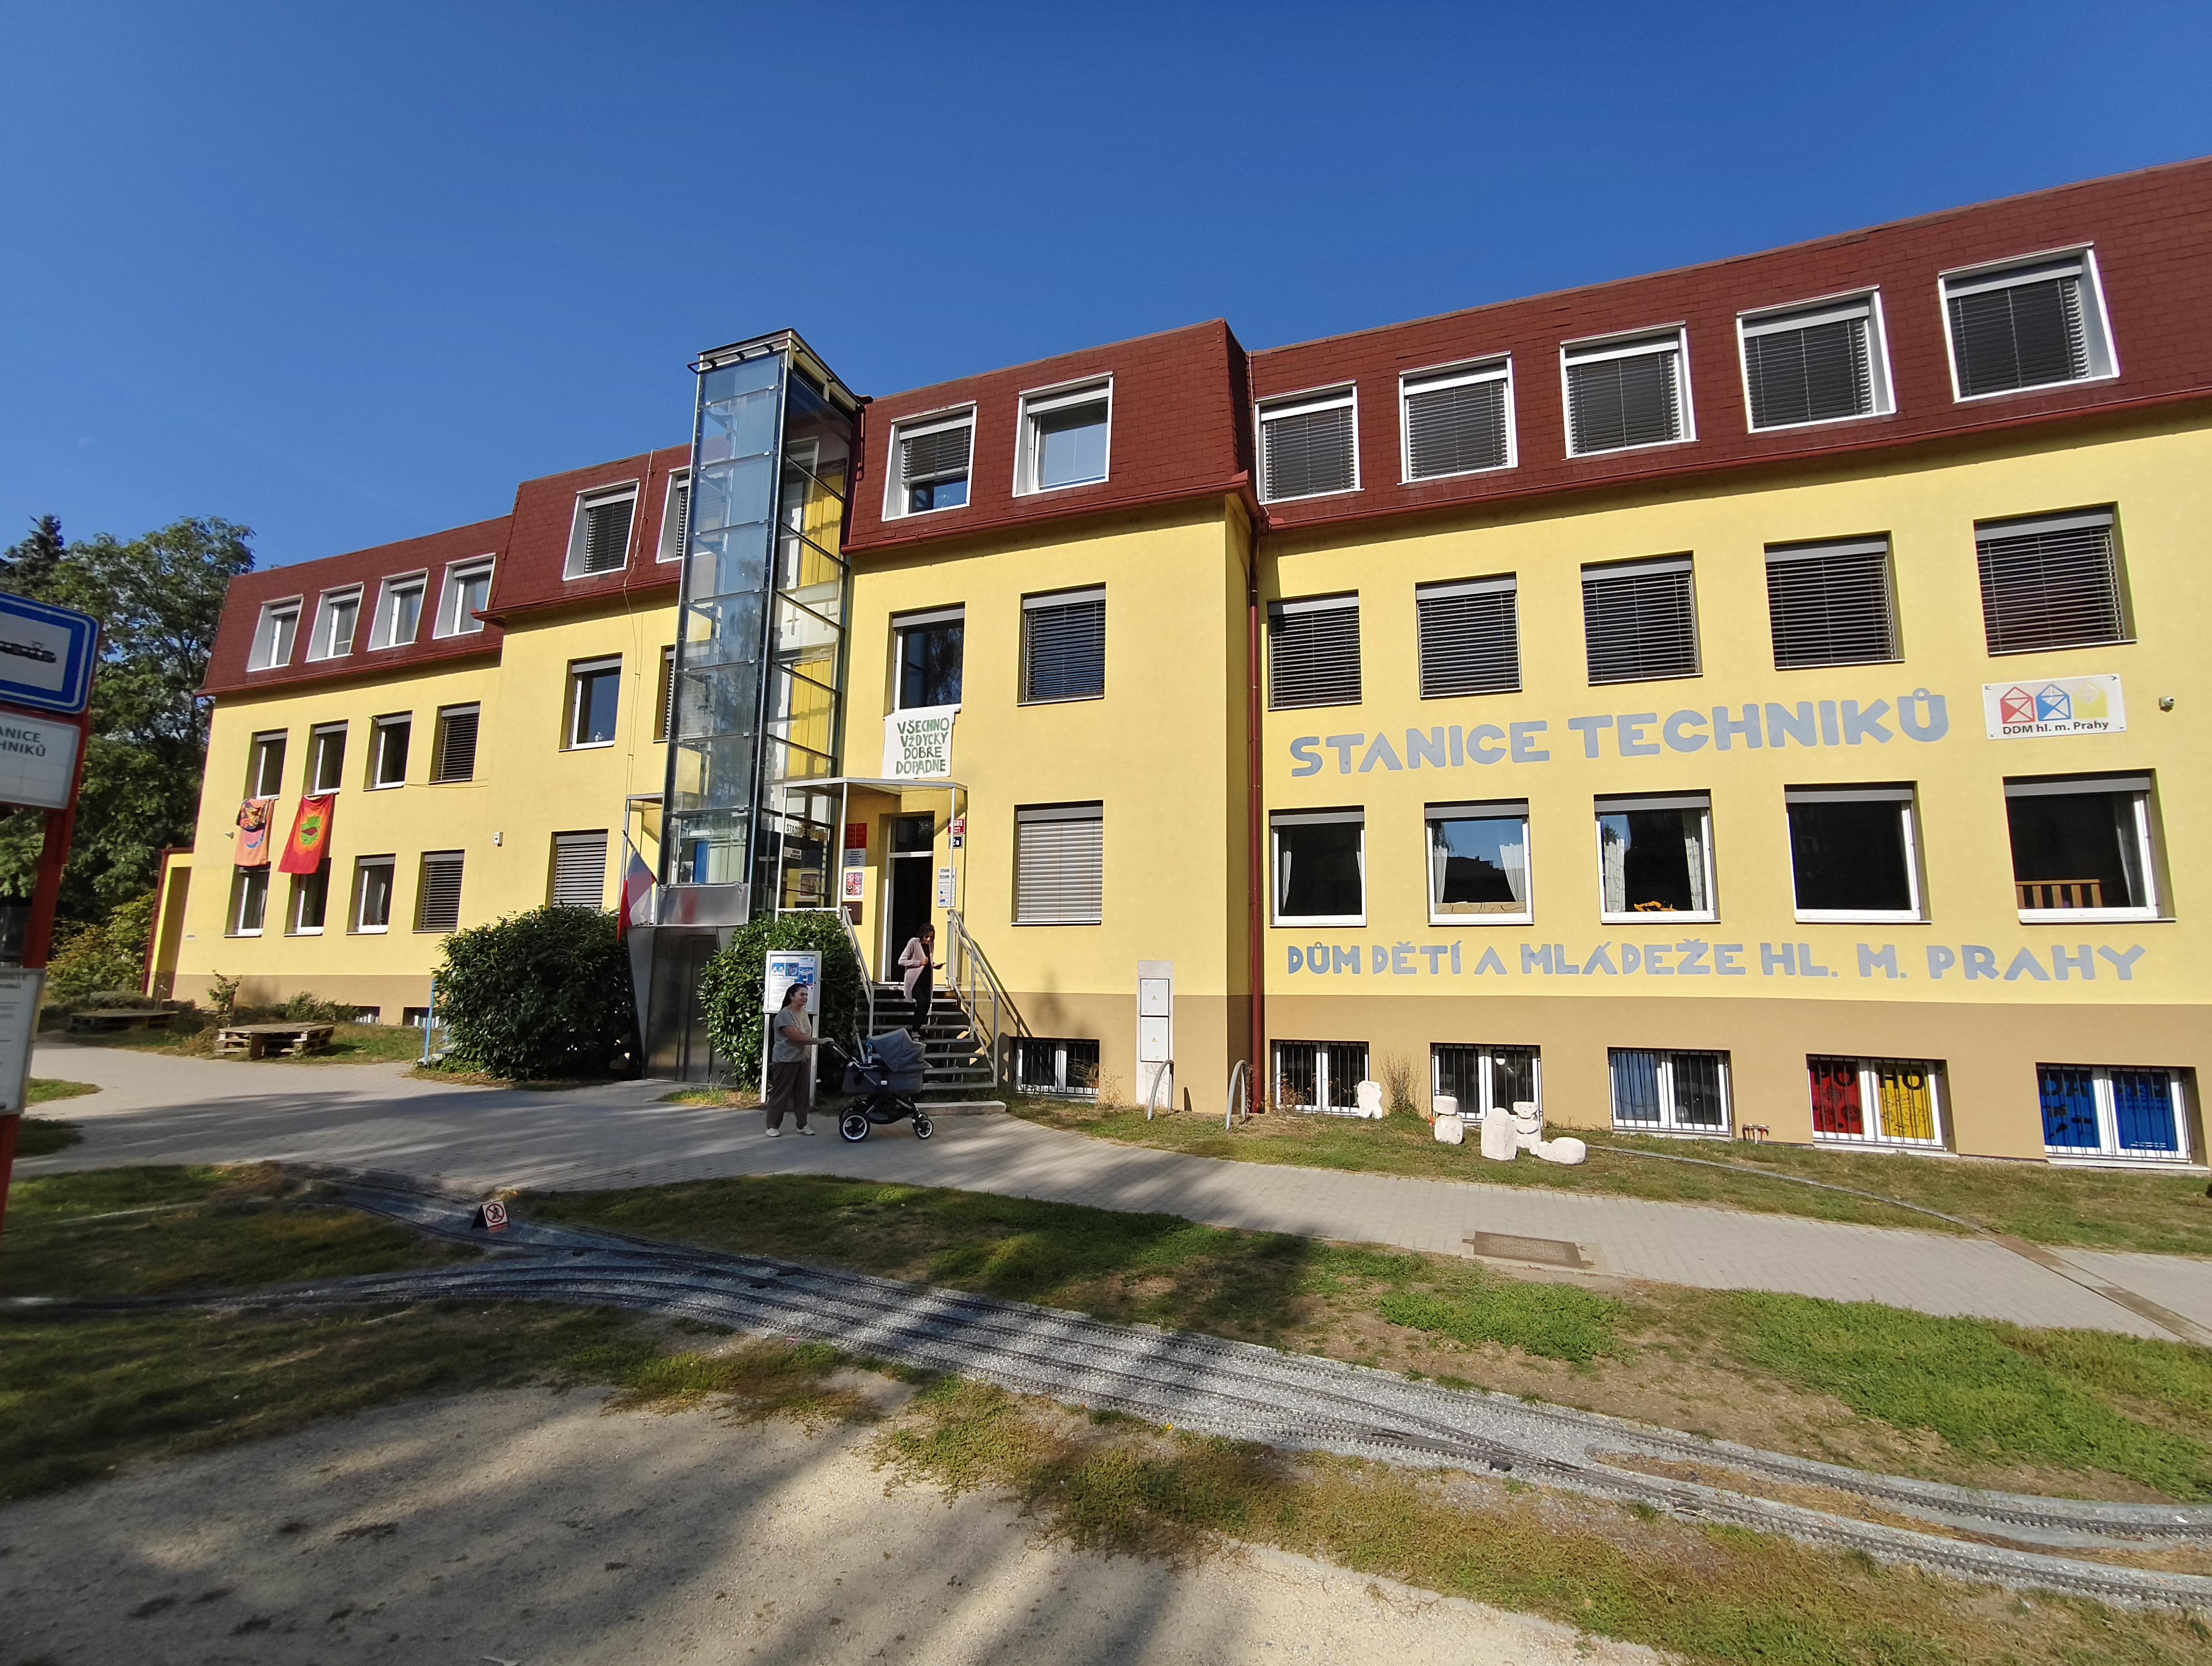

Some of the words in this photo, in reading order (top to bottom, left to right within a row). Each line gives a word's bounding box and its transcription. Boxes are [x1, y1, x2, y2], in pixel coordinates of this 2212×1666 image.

[897, 717, 949, 735] VŠECHNO
[1290, 721, 1550, 777] STANICE
[1568, 688, 1948, 759] TECHNIKŮ
[2003, 725, 2033, 735] DDM
[2036, 724, 2052, 732] hl.
[2074, 721, 2109, 730] Prahy
[901, 731, 948, 747] VŽDYCKY
[904, 746, 942, 760] DOBŘE
[896, 759, 946, 775] DOPADNE
[1288, 941, 1361, 974] DŮM
[1372, 940, 1462, 975] DĚTÍ
[1474, 945, 1507, 975] A
[1520, 939, 1746, 975] MLÁDEŽE
[1760, 943, 1838, 977] HL.
[1857, 944, 1907, 978] M.
[1926, 944, 2145, 980] PRAHY
